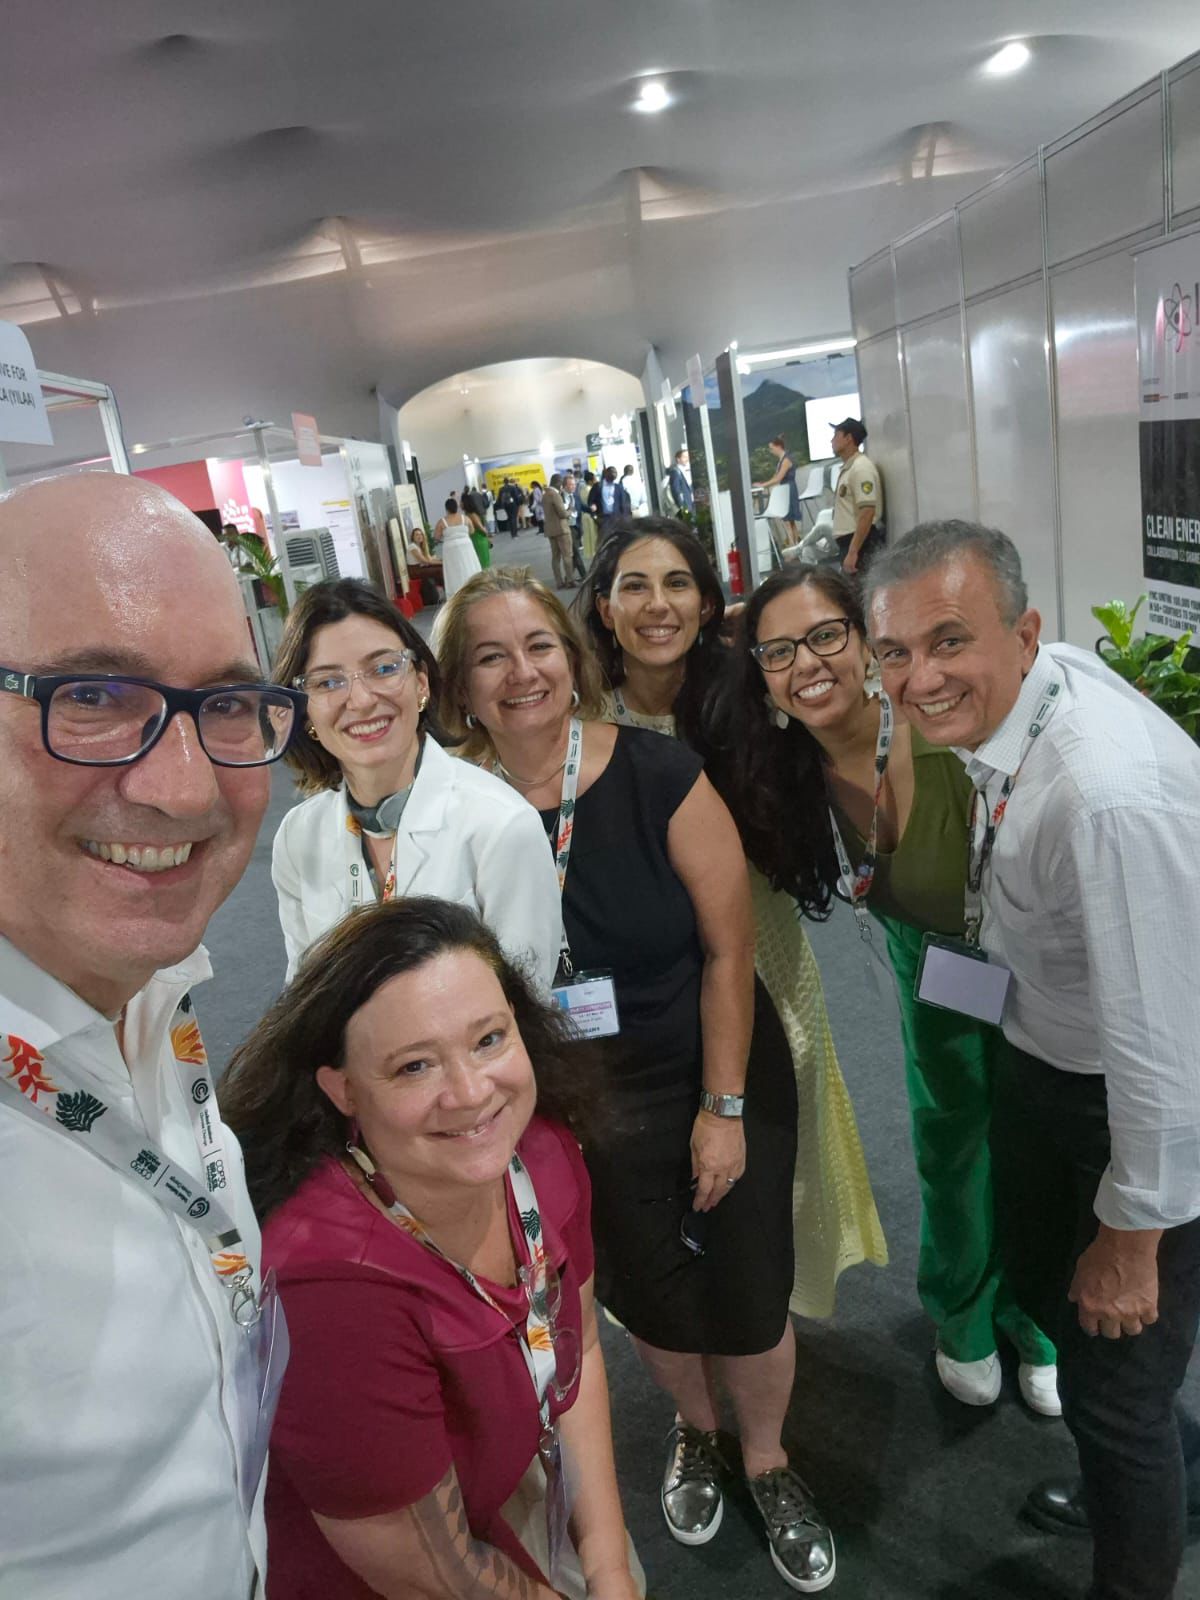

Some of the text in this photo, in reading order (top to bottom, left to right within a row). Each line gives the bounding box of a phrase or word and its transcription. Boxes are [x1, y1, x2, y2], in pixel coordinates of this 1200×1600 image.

[11, 364, 27, 381] FOR
[8, 389, 36, 408] (YILAA)
[1146, 514, 1174, 540] CLEAN
[130, 1159, 153, 1180] COP30
[136, 1152, 159, 1174] BRASIL
[215, 1159, 226, 1189] COP30
[209, 1161, 219, 1193] BRASIL
